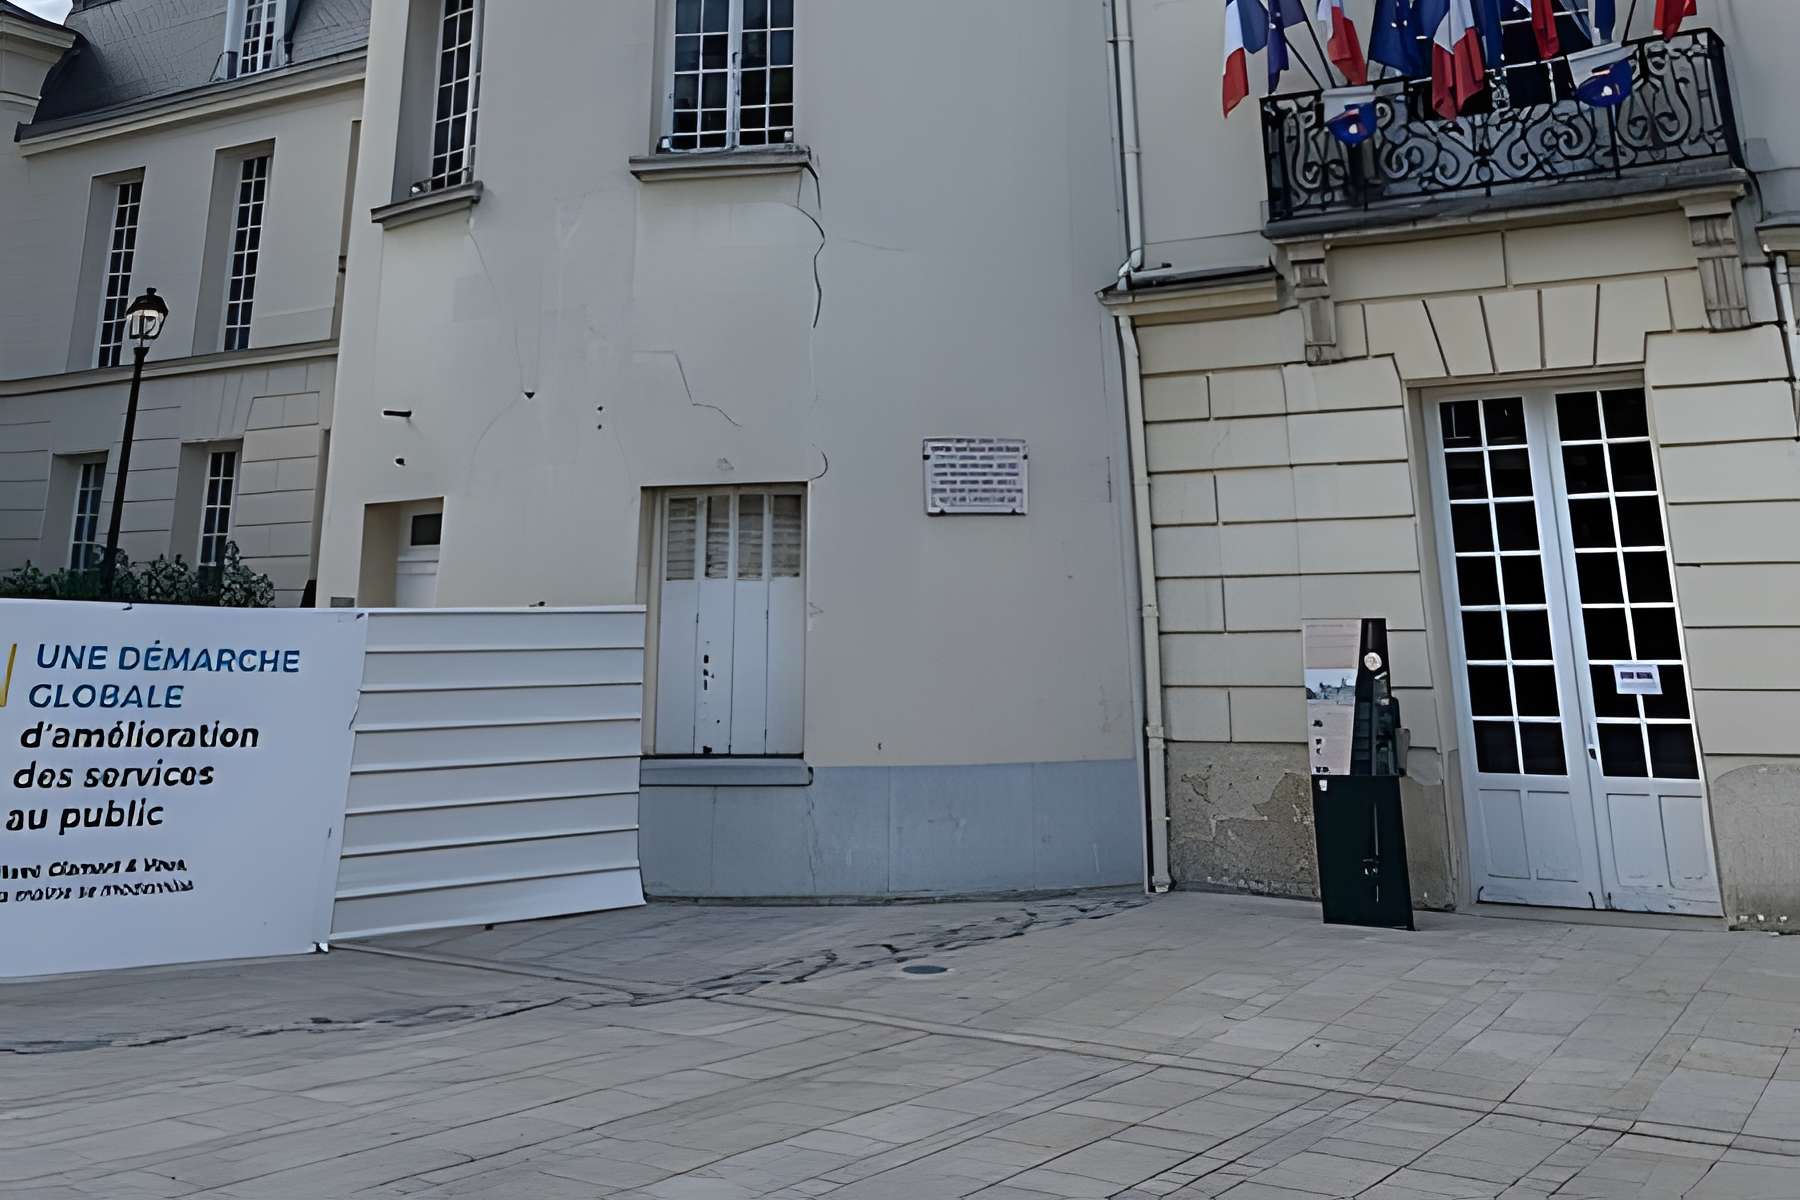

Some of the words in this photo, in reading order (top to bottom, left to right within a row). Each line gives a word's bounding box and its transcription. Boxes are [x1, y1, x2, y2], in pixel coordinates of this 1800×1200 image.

[36, 643, 109, 670] UNE
[118, 639, 300, 673] DÉMARCHE
[28, 683, 185, 709] GLOBALE
[5, 808, 49, 832] au
[58, 797, 164, 836] public
